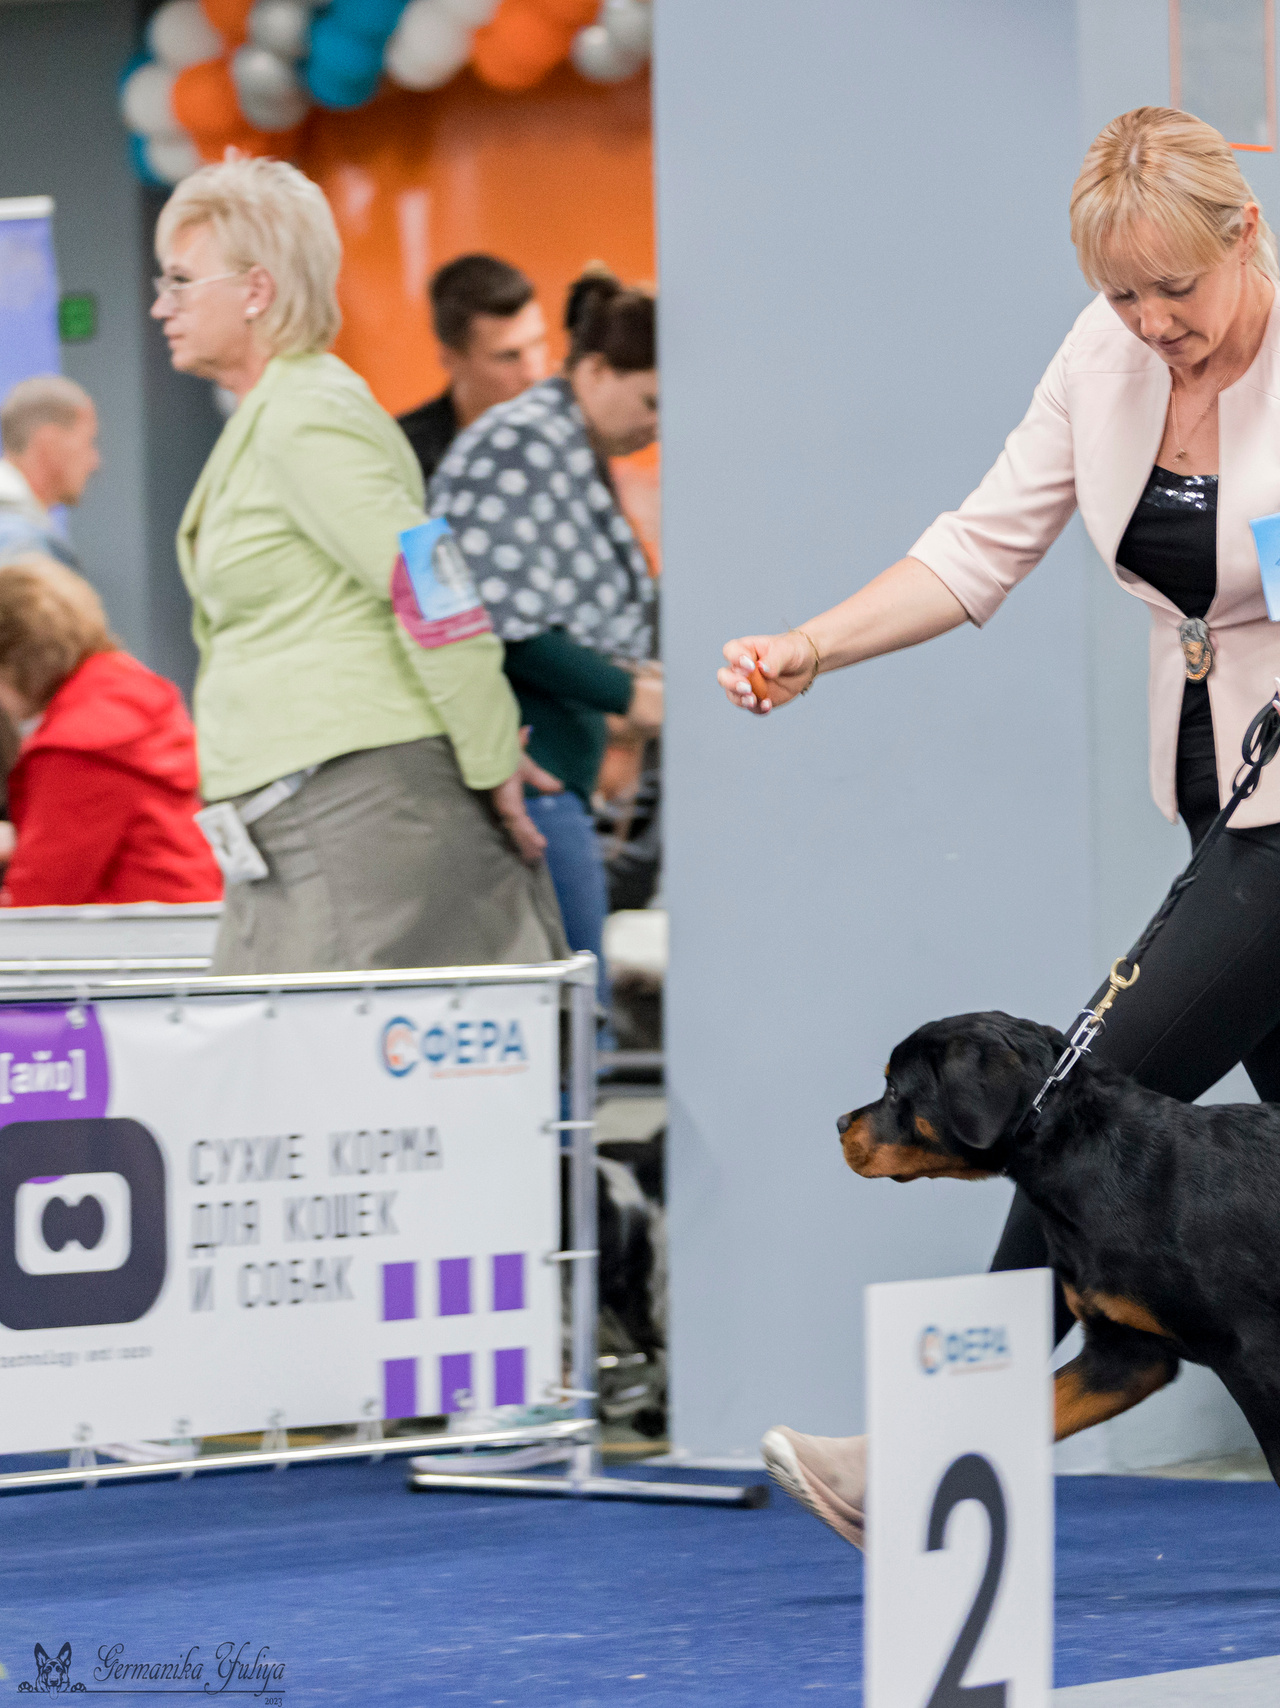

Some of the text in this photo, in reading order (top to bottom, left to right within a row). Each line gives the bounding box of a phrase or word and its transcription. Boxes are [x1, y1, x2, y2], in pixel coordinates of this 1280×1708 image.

[189, 1126, 443, 1186] СУХИЕ КОРМА
[187, 1190, 400, 1260] ДЛЯ КОШЕК
[189, 1256, 356, 1312] И СОБАК
[922, 1452, 1013, 1708] 2
